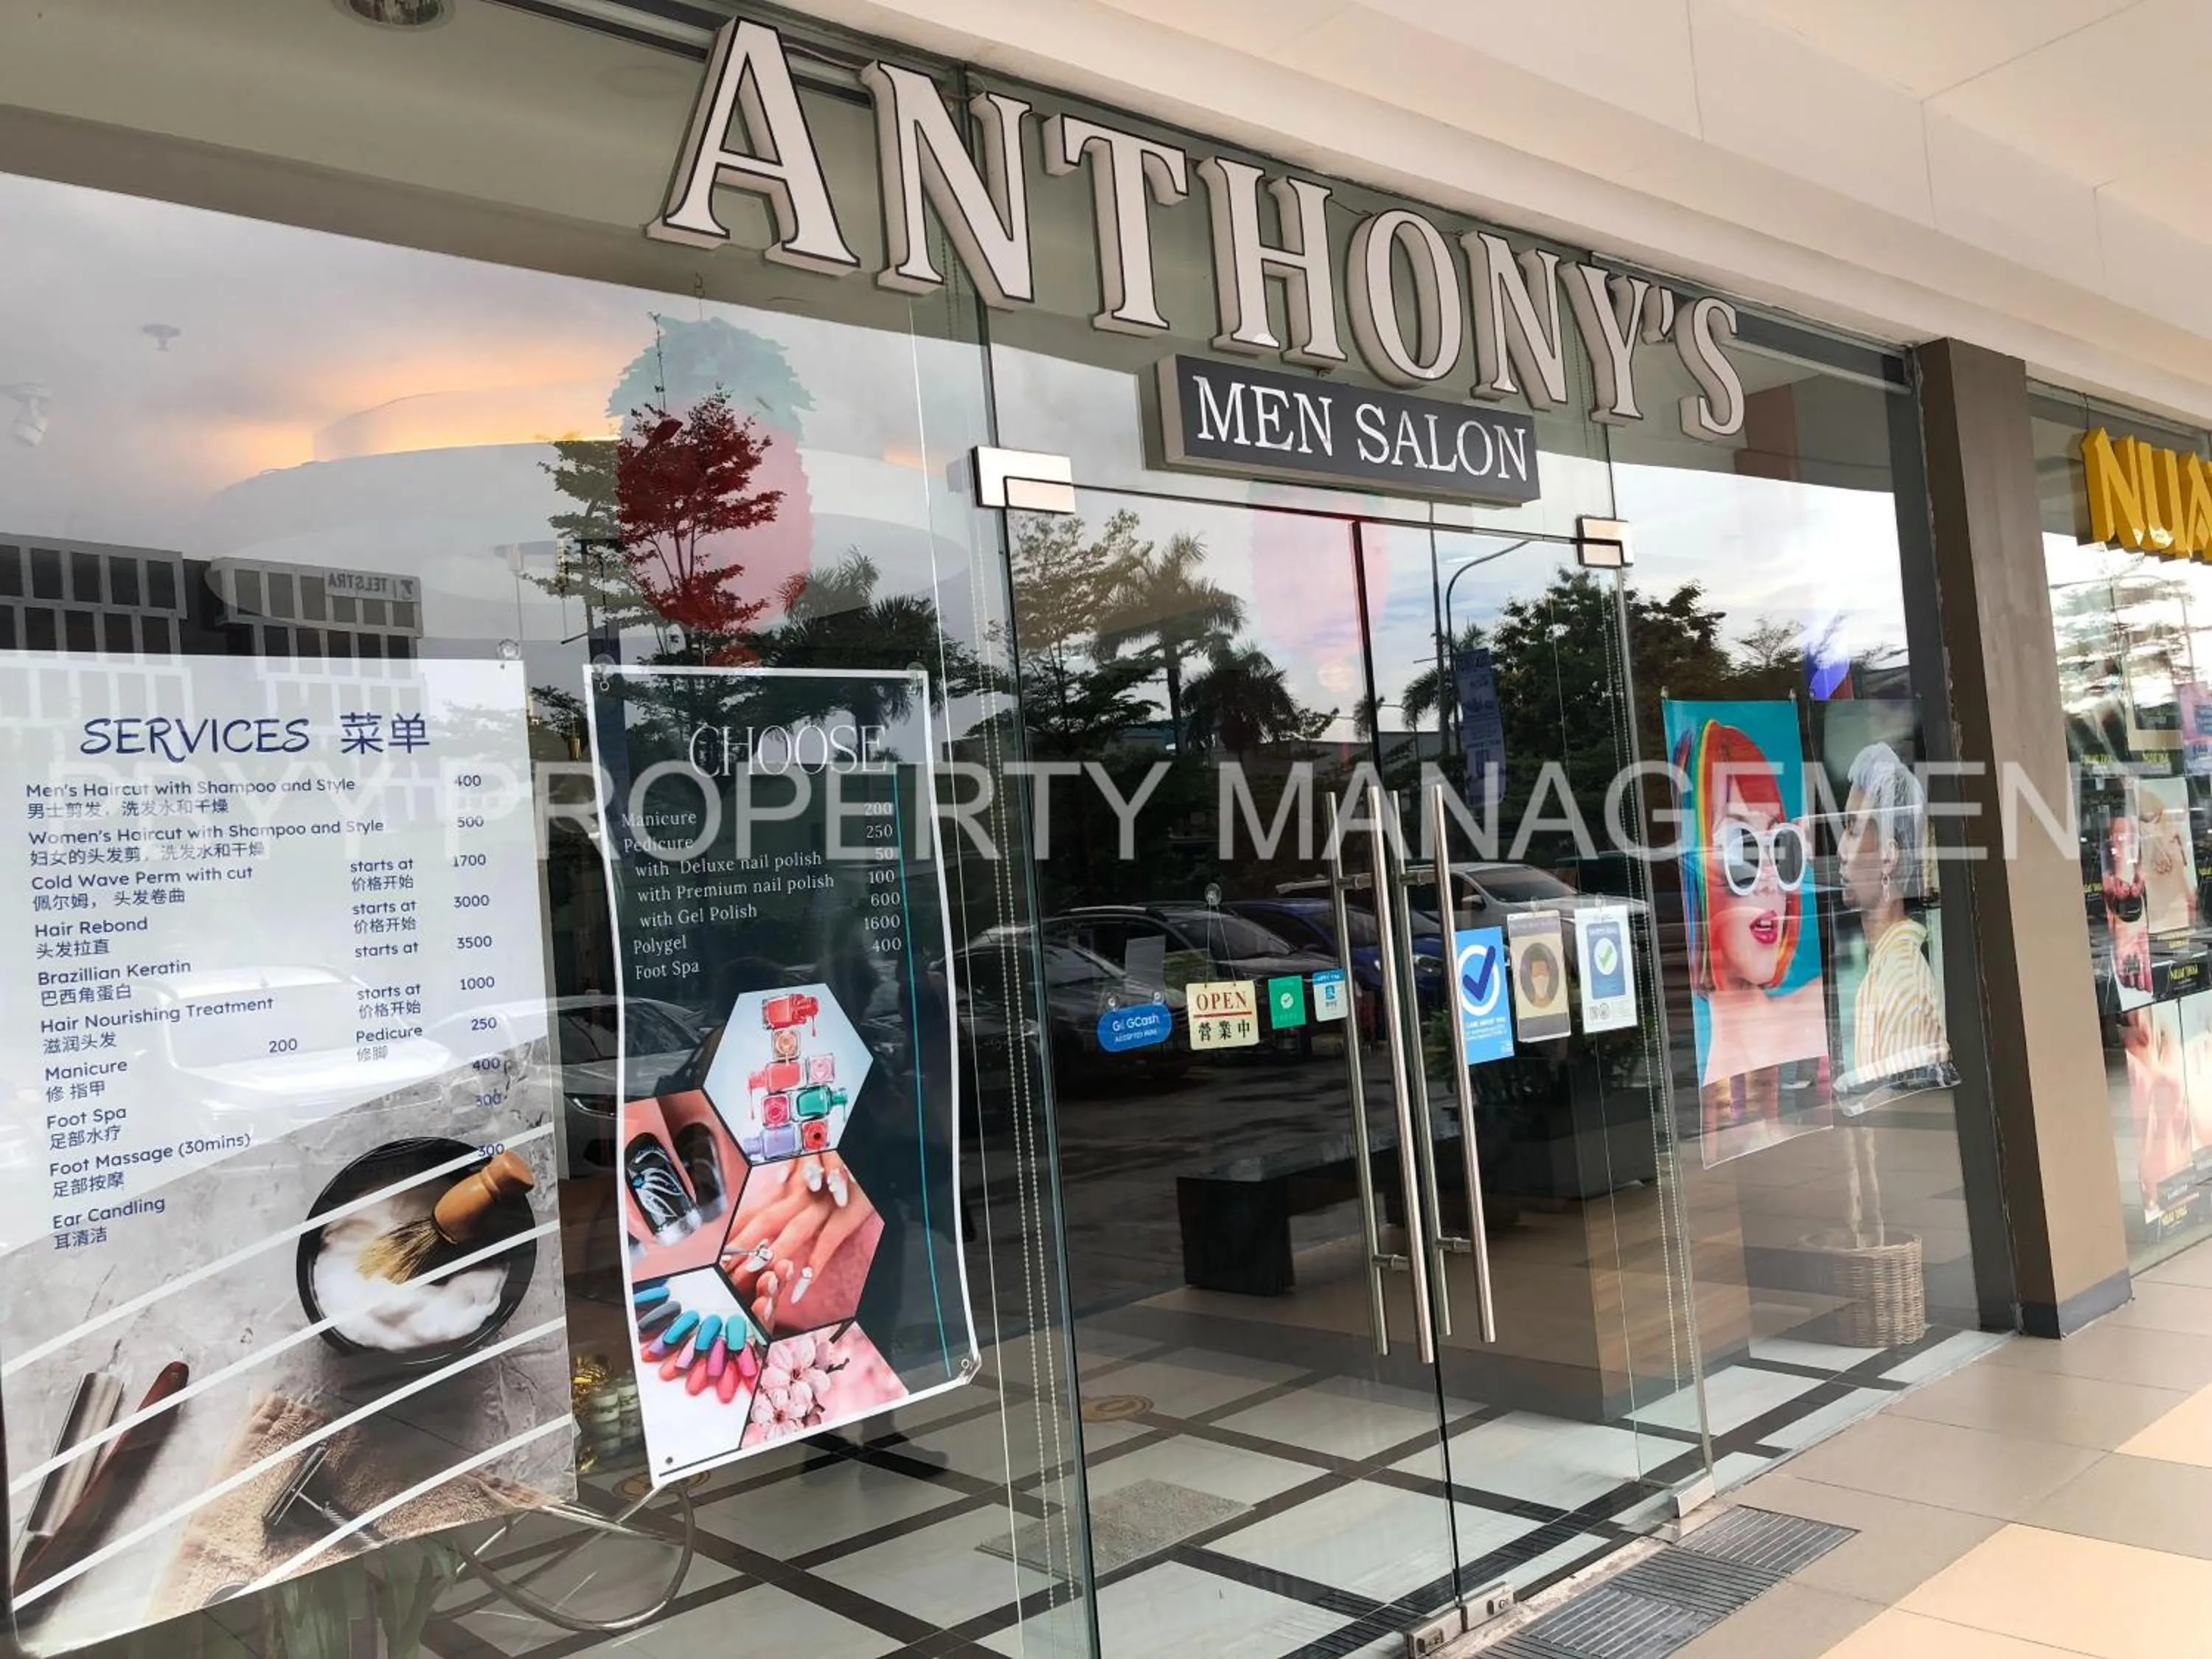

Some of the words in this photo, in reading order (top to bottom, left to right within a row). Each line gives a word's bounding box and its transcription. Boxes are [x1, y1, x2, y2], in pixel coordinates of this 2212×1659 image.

[650, 15, 1746, 439] ANTHONY'S
[1192, 374, 1335, 457] MEN
[1355, 402, 1529, 484] SALON
[2081, 426, 2212, 561] NUA
[80, 717, 310, 763] SERVICES
[340, 712, 431, 755] 菜单
[689, 725, 888, 778] CHOOSE
[26, 783, 77, 799] Men's
[83, 781, 148, 796] Haircut
[154, 780, 192, 795] with
[197, 779, 276, 796] Shampoo
[281, 778, 312, 792] and
[316, 777, 355, 794] Style
[455, 775, 483, 787] 400
[622, 810, 698, 828] Manicure
[863, 801, 894, 816] 200
[29, 829, 111, 846] Women's
[117, 827, 182, 842] Haircut
[187, 825, 223, 841] with
[229, 823, 306, 839] Shampoo
[311, 821, 341, 835] and
[346, 819, 384, 838] Style
[457, 815, 484, 829] 500
[865, 824, 894, 840] 250
[624, 835, 695, 854] Pedicure
[874, 847, 894, 861] 50
[350, 860, 393, 874] starts
[398, 858, 414, 871] at
[453, 854, 487, 868] 1700
[635, 861, 669, 878] with
[680, 858, 735, 875] Deluxe
[740, 855, 769, 872] nail
[774, 850, 822, 872] polish
[32, 874, 72, 891] Cold
[77, 872, 130, 888] Wave
[136, 871, 181, 886] Perm
[186, 867, 222, 883] with
[226, 866, 253, 880] cut
[352, 874, 414, 892] 价格开始
[867, 869, 896, 884] 100
[637, 886, 672, 903] with
[677, 882, 748, 900] Premium
[752, 877, 782, 894] nail
[787, 874, 835, 894] polish
[871, 891, 901, 907] 600
[352, 902, 396, 916] starts
[400, 900, 417, 913] at
[453, 894, 490, 908] 3000
[354, 916, 417, 935] 价格开始
[639, 912, 673, 929] with
[678, 907, 705, 925] Gel
[709, 902, 758, 922] Polish
[863, 914, 901, 931] 1600
[35, 923, 73, 938] Hair
[80, 917, 148, 934] Rebond
[36, 938, 111, 960] 头发拉直
[355, 944, 398, 959] starts
[403, 942, 419, 954] at
[456, 936, 493, 950] 3500
[633, 934, 688, 959] Polygel
[872, 936, 902, 953] 400
[38, 967, 121, 987] Brazillian
[127, 959, 192, 978] Keratin
[635, 964, 667, 981] Foot
[672, 959, 700, 979] Spa
[357, 985, 400, 1001] starts
[405, 983, 421, 996] at
[459, 975, 495, 992] 1000
[41, 982, 131, 1008] 巴西角蛋白
[1197, 990, 1248, 1012] OPEN
[41, 1016, 79, 1034] Hair
[85, 1008, 181, 1029] Nourishing
[186, 997, 274, 1018] Treatment
[358, 999, 422, 1020] 价格开始
[471, 1017, 498, 1031] 250
[1126, 1012, 1161, 1029] GCash
[43, 1031, 118, 1055] 滋润头发
[356, 1026, 423, 1043] Pedicure
[268, 1037, 299, 1054] 200
[45, 1060, 128, 1082] Manicure
[472, 1058, 501, 1071] 400
[46, 1111, 88, 1130] Foot
[93, 1107, 128, 1126] Spa
[49, 1124, 122, 1151] 足部水疗
[49, 1158, 89, 1177] Foot
[96, 1145, 173, 1169] Massage
[178, 1133, 251, 1158] (30mins)
[479, 1143, 505, 1157] 300
[52, 1170, 125, 1200] 足部按摩
[52, 1211, 83, 1230] Ear
[88, 1197, 165, 1222] Candling
[54, 1225, 108, 1251] 耳清洁
